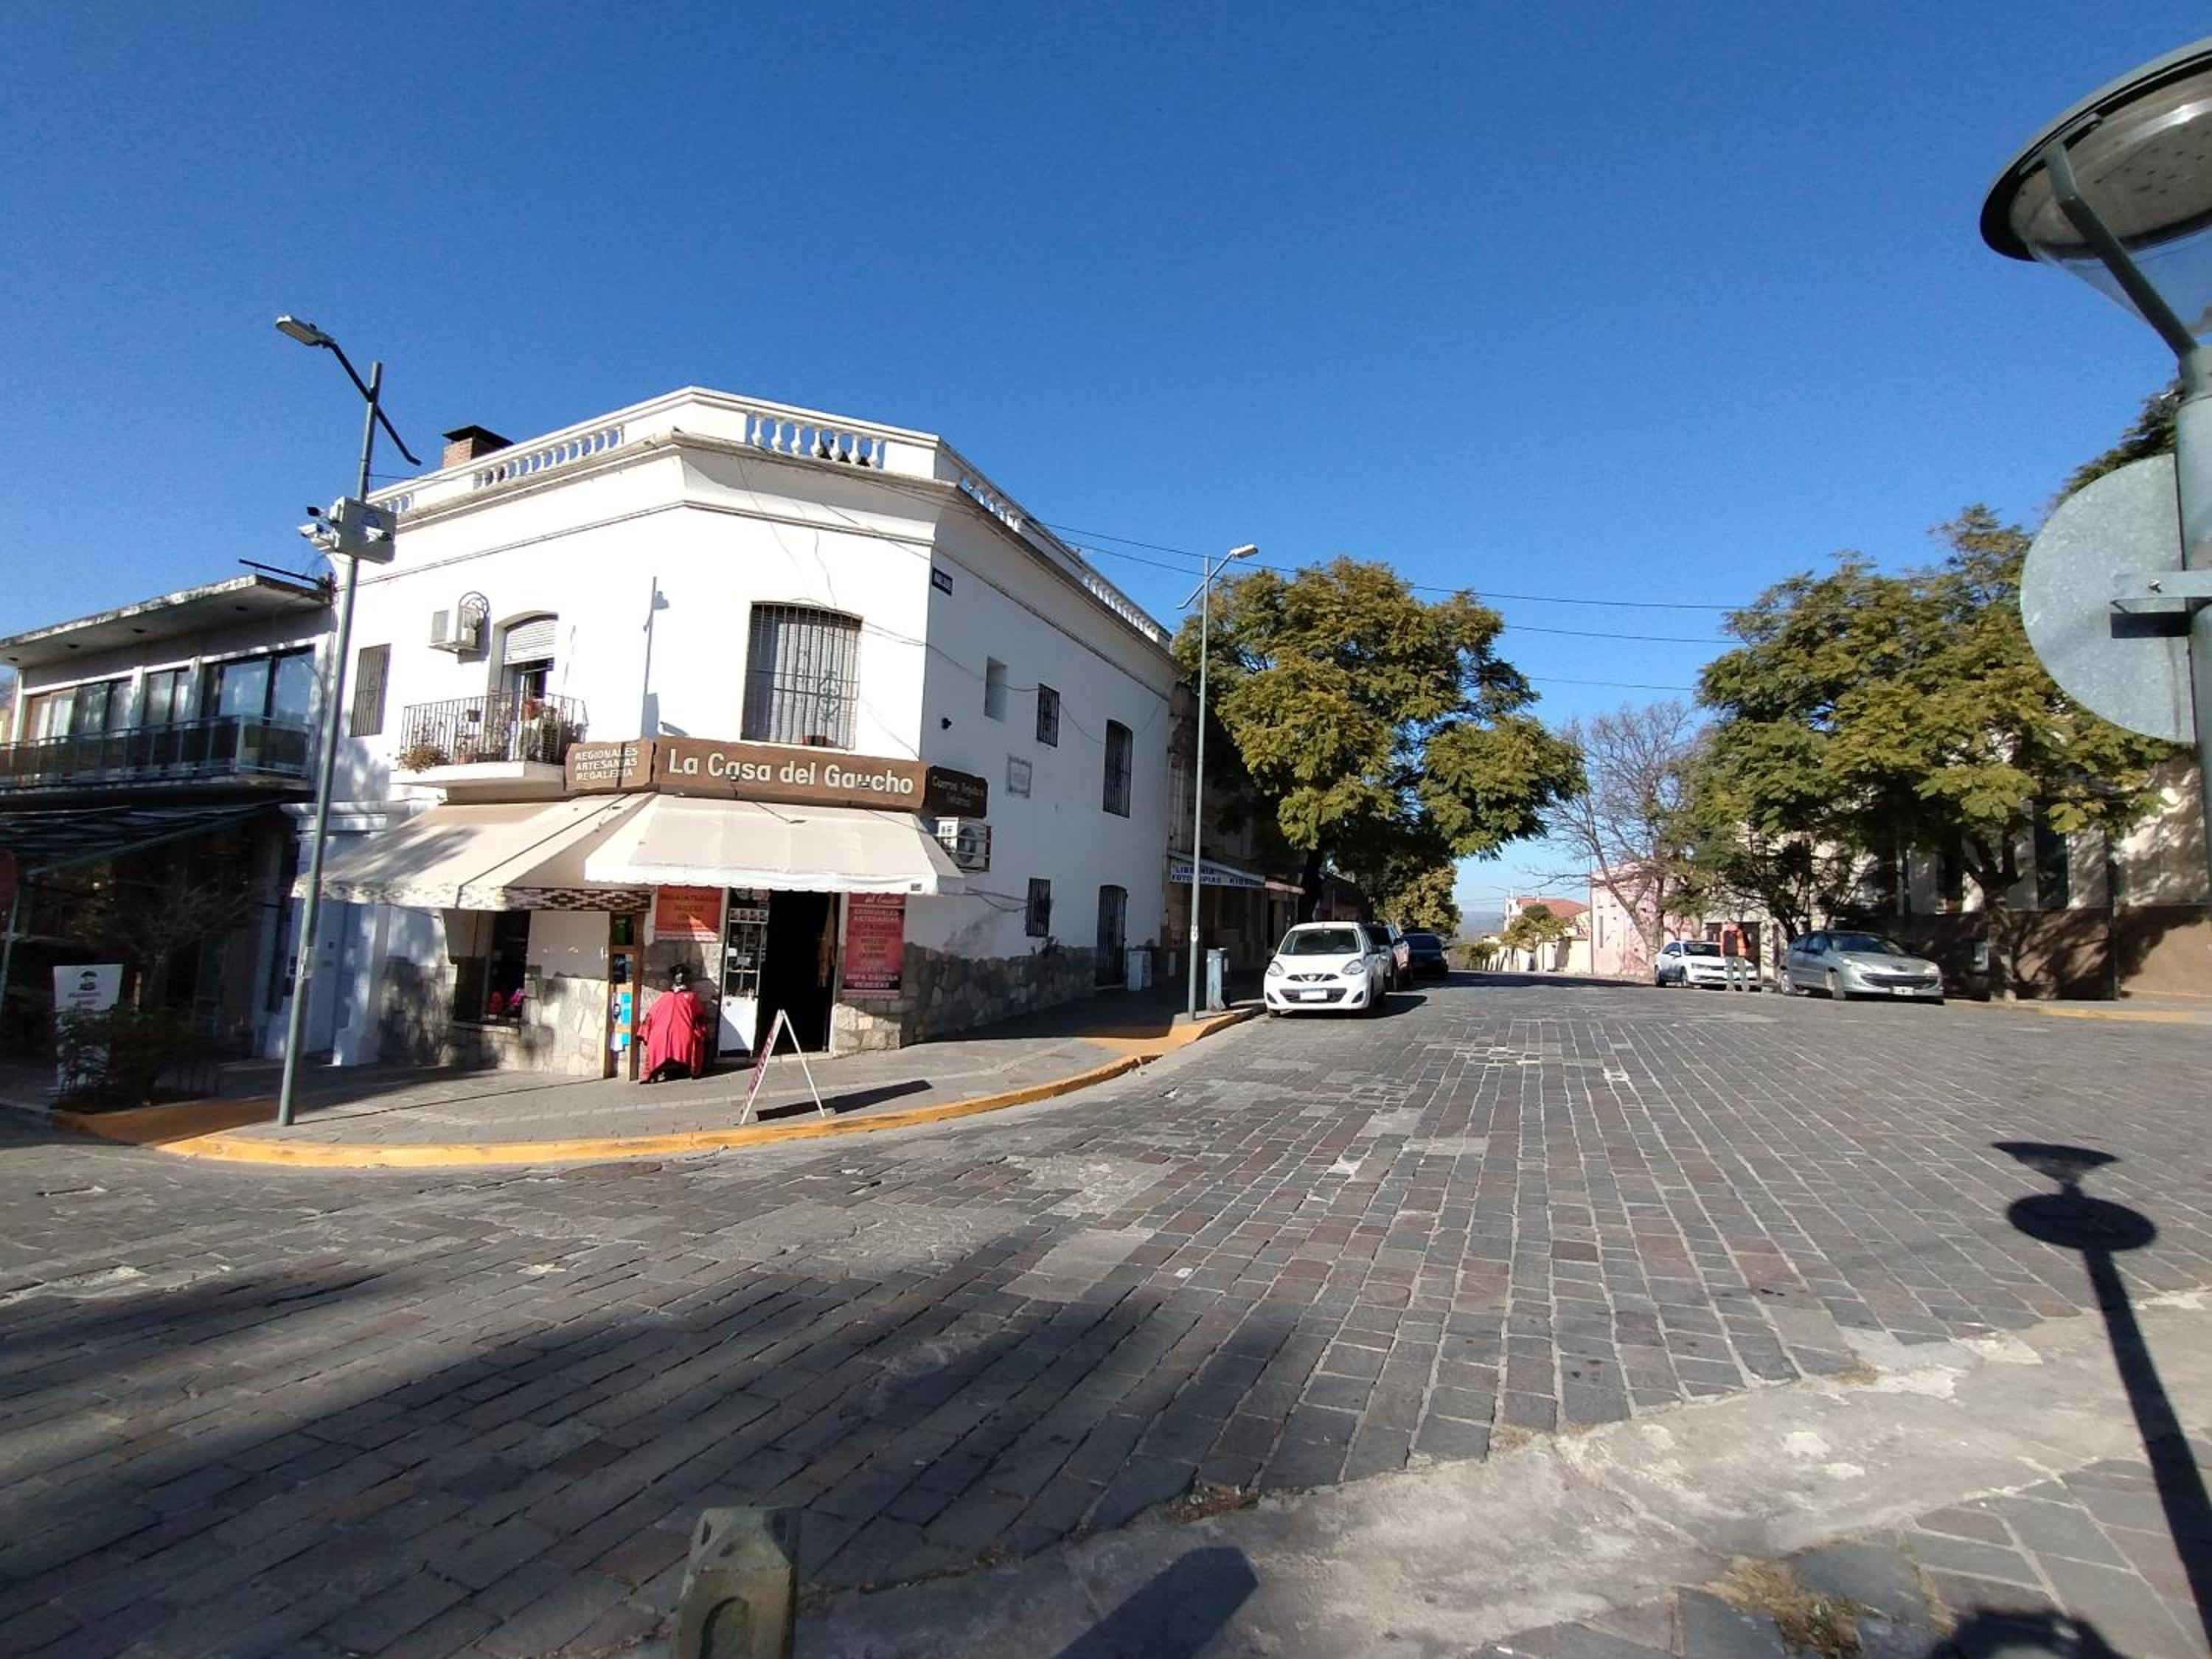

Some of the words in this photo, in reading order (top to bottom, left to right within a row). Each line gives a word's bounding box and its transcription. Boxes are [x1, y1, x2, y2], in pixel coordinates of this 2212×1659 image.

[574, 746, 638, 762] REGIONALES
[669, 748, 698, 774] La
[707, 752, 771, 782] Casa
[779, 760, 816, 785] del
[824, 764, 914, 794] Gaucho
[1175, 866, 1215, 874] LIBRRIA
[1172, 873, 1221, 883] FOTOPIAS
